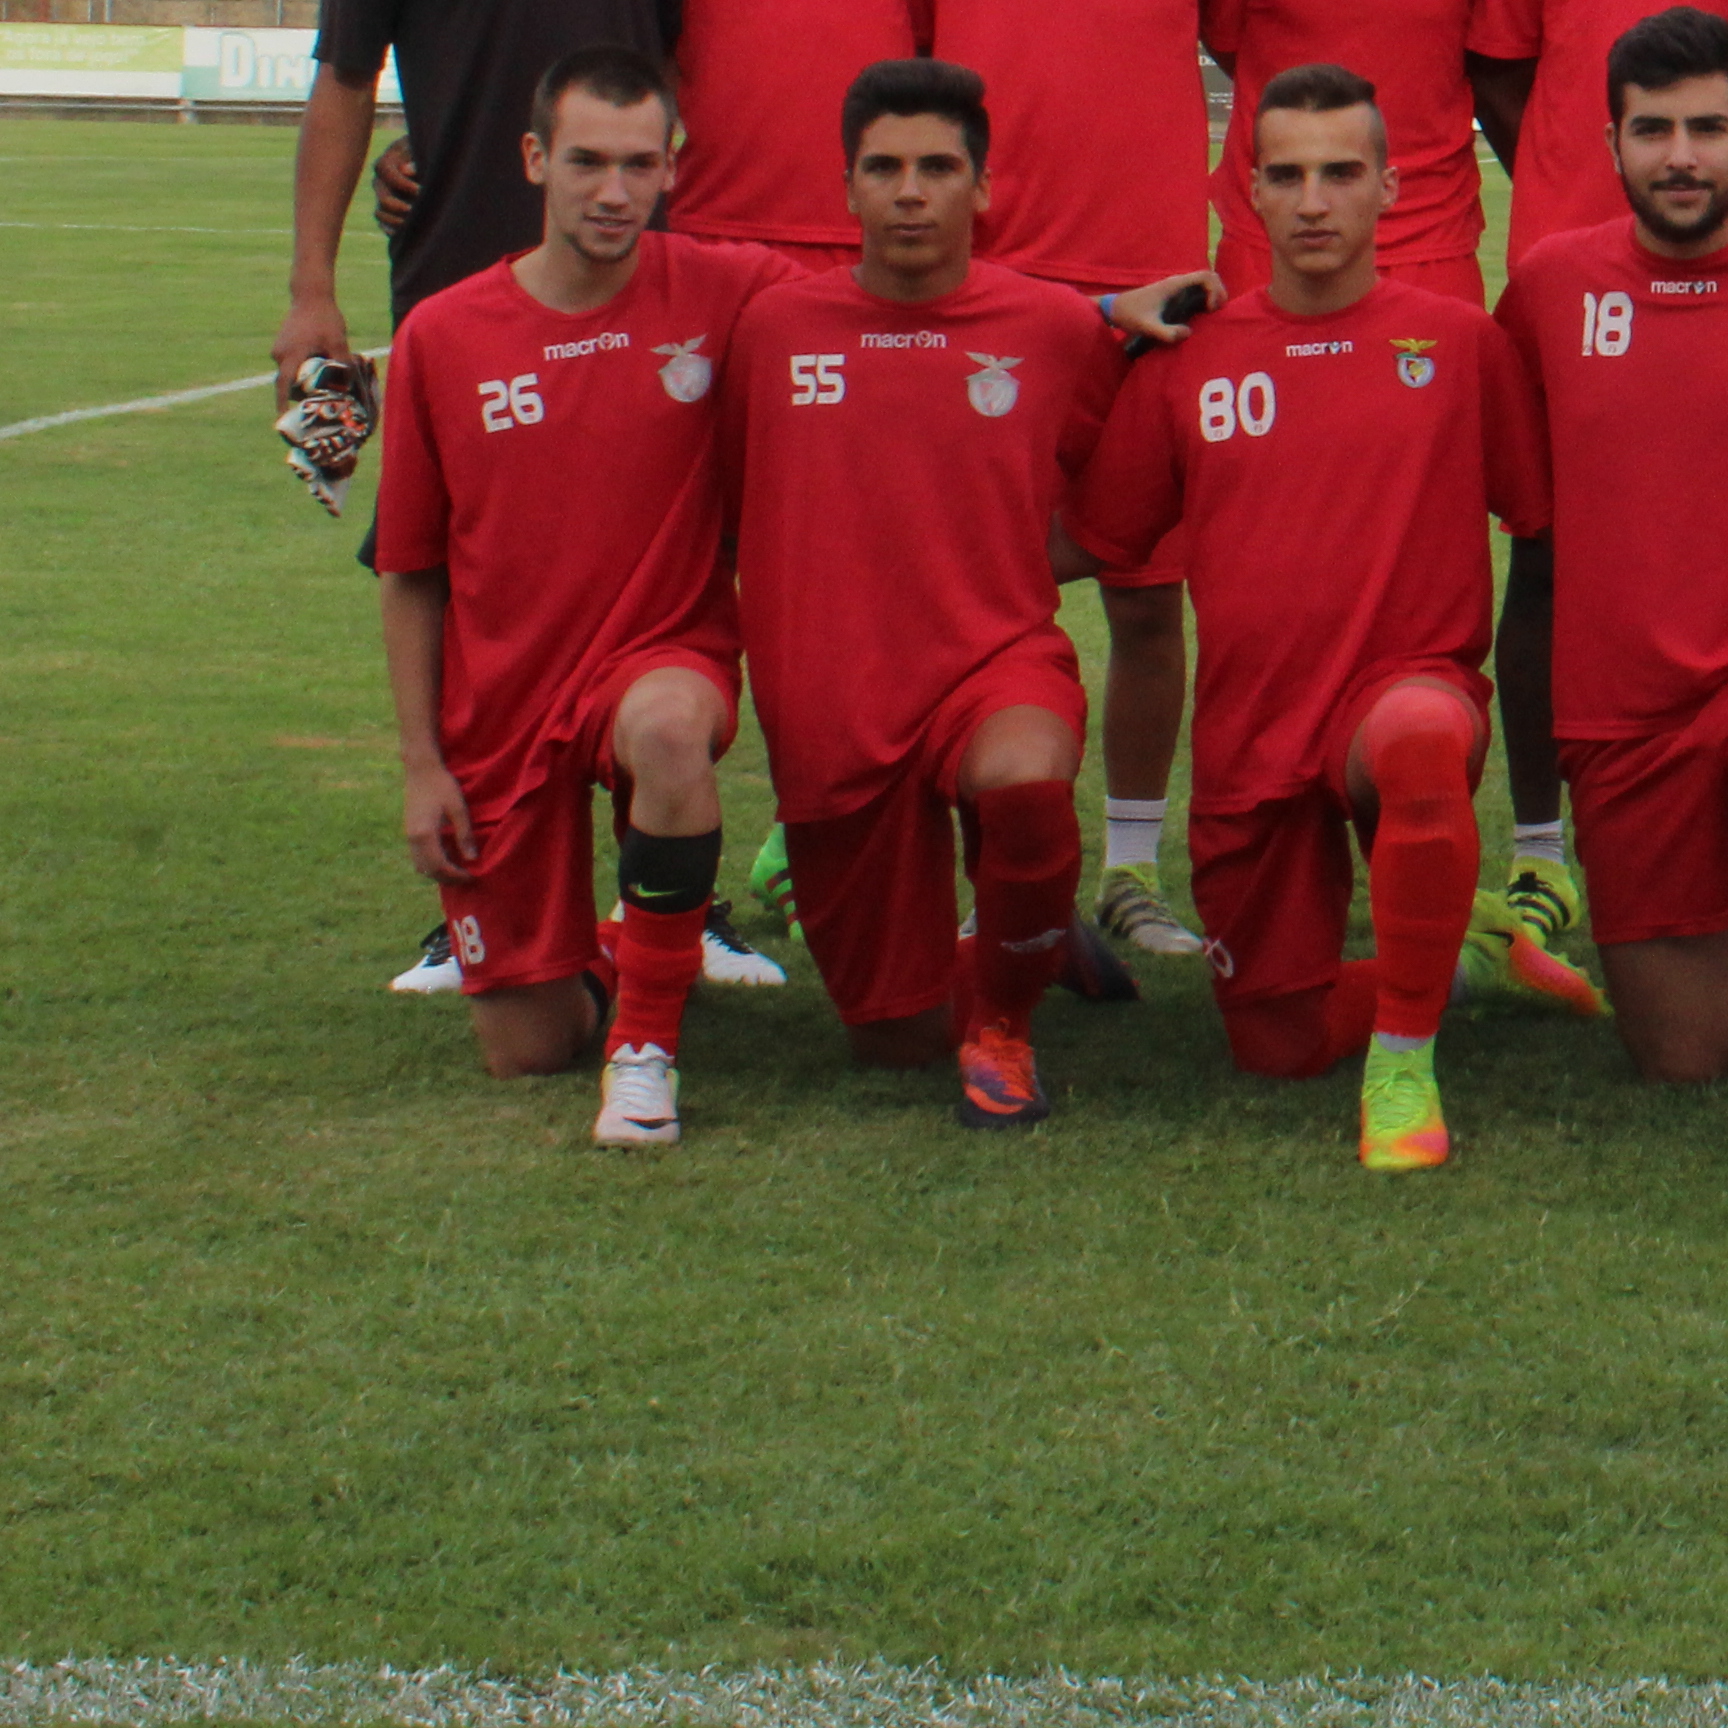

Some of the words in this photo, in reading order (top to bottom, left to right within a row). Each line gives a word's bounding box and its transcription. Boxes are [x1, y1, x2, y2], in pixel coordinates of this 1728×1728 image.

[1651, 281, 1717, 294] macron
[861, 331, 946, 348] macron
[1582, 292, 1633, 356] 18
[544, 333, 629, 361] macron
[1286, 341, 1352, 357] macron
[790, 354, 844, 405] 55
[478, 373, 544, 432] 26
[1199, 372, 1275, 442] 80
